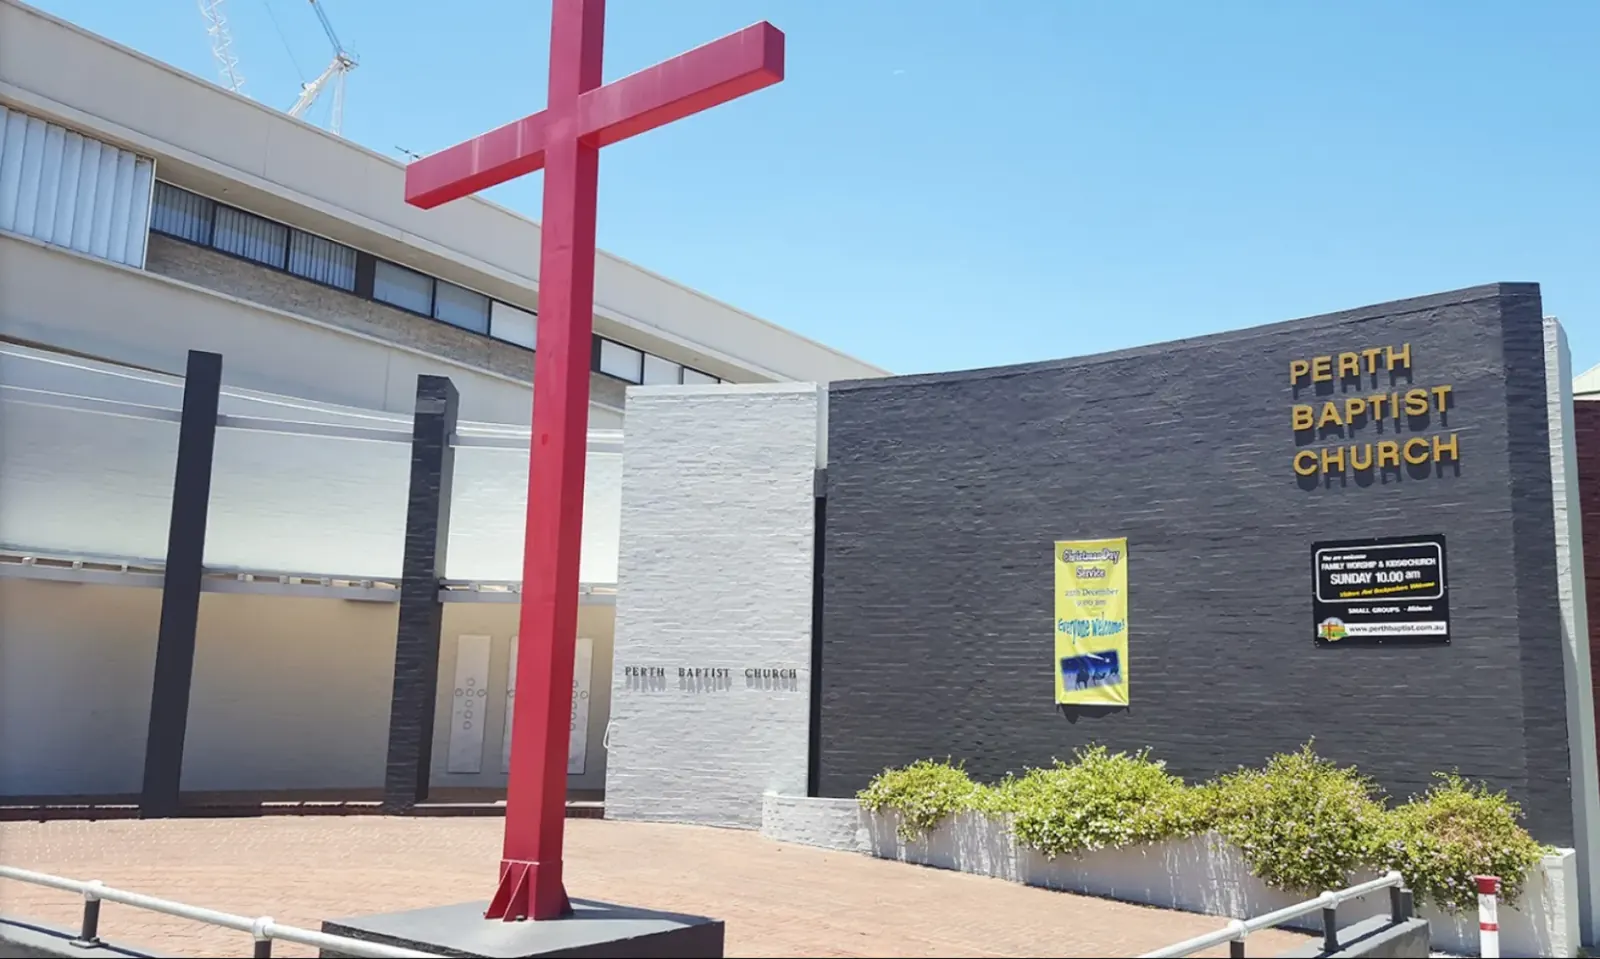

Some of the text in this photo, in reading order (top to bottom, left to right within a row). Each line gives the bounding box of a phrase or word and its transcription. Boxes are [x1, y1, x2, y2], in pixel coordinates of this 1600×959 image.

[1290, 343, 1411, 385] PERTH
[1292, 385, 1452, 430] BAPTIST
[1293, 434, 1458, 475] CHURCH
[1101, 548, 1119, 564] Day
[1076, 566, 1105, 578] Service
[1321, 562, 1345, 570] FAMILY
[1346, 560, 1377, 569] WORSHIP
[1330, 570, 1421, 585] SUNDAY 10.00 am
[1082, 588, 1118, 596] December
[1058, 618, 1089, 644] Everyone
[1349, 624, 1444, 632] www.perthbaptist.com.au
[625, 667, 797, 679] PERTH BAPTIST CHURCH
